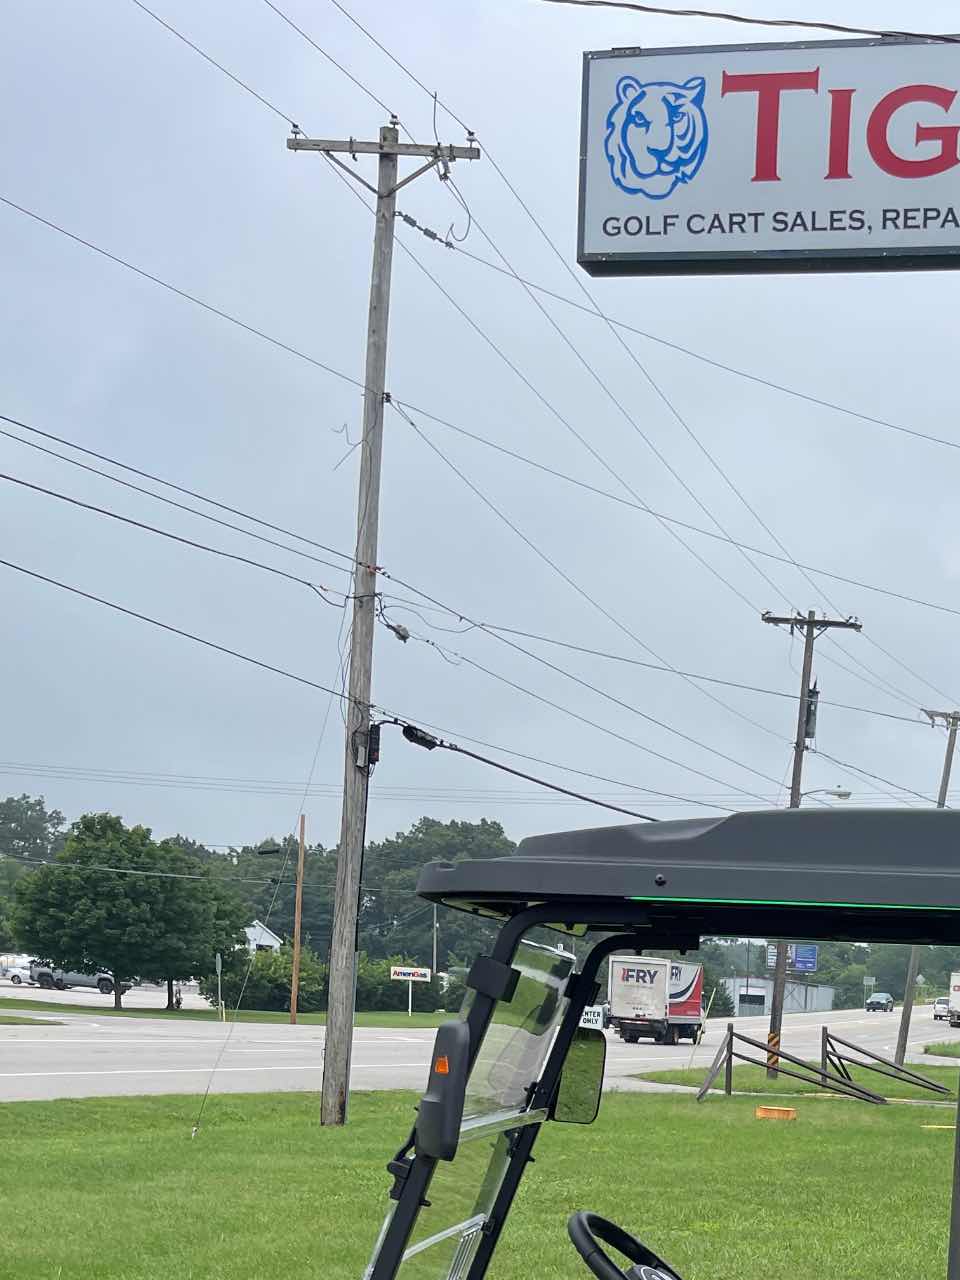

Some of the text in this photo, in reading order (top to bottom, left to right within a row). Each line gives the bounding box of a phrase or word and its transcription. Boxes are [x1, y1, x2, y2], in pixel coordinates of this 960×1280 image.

[602, 214, 680, 237] GOLF
[686, 212, 766, 235] CART
[772, 209, 874, 235] SALES,
[582, 1017, 599, 1025] ONLY
